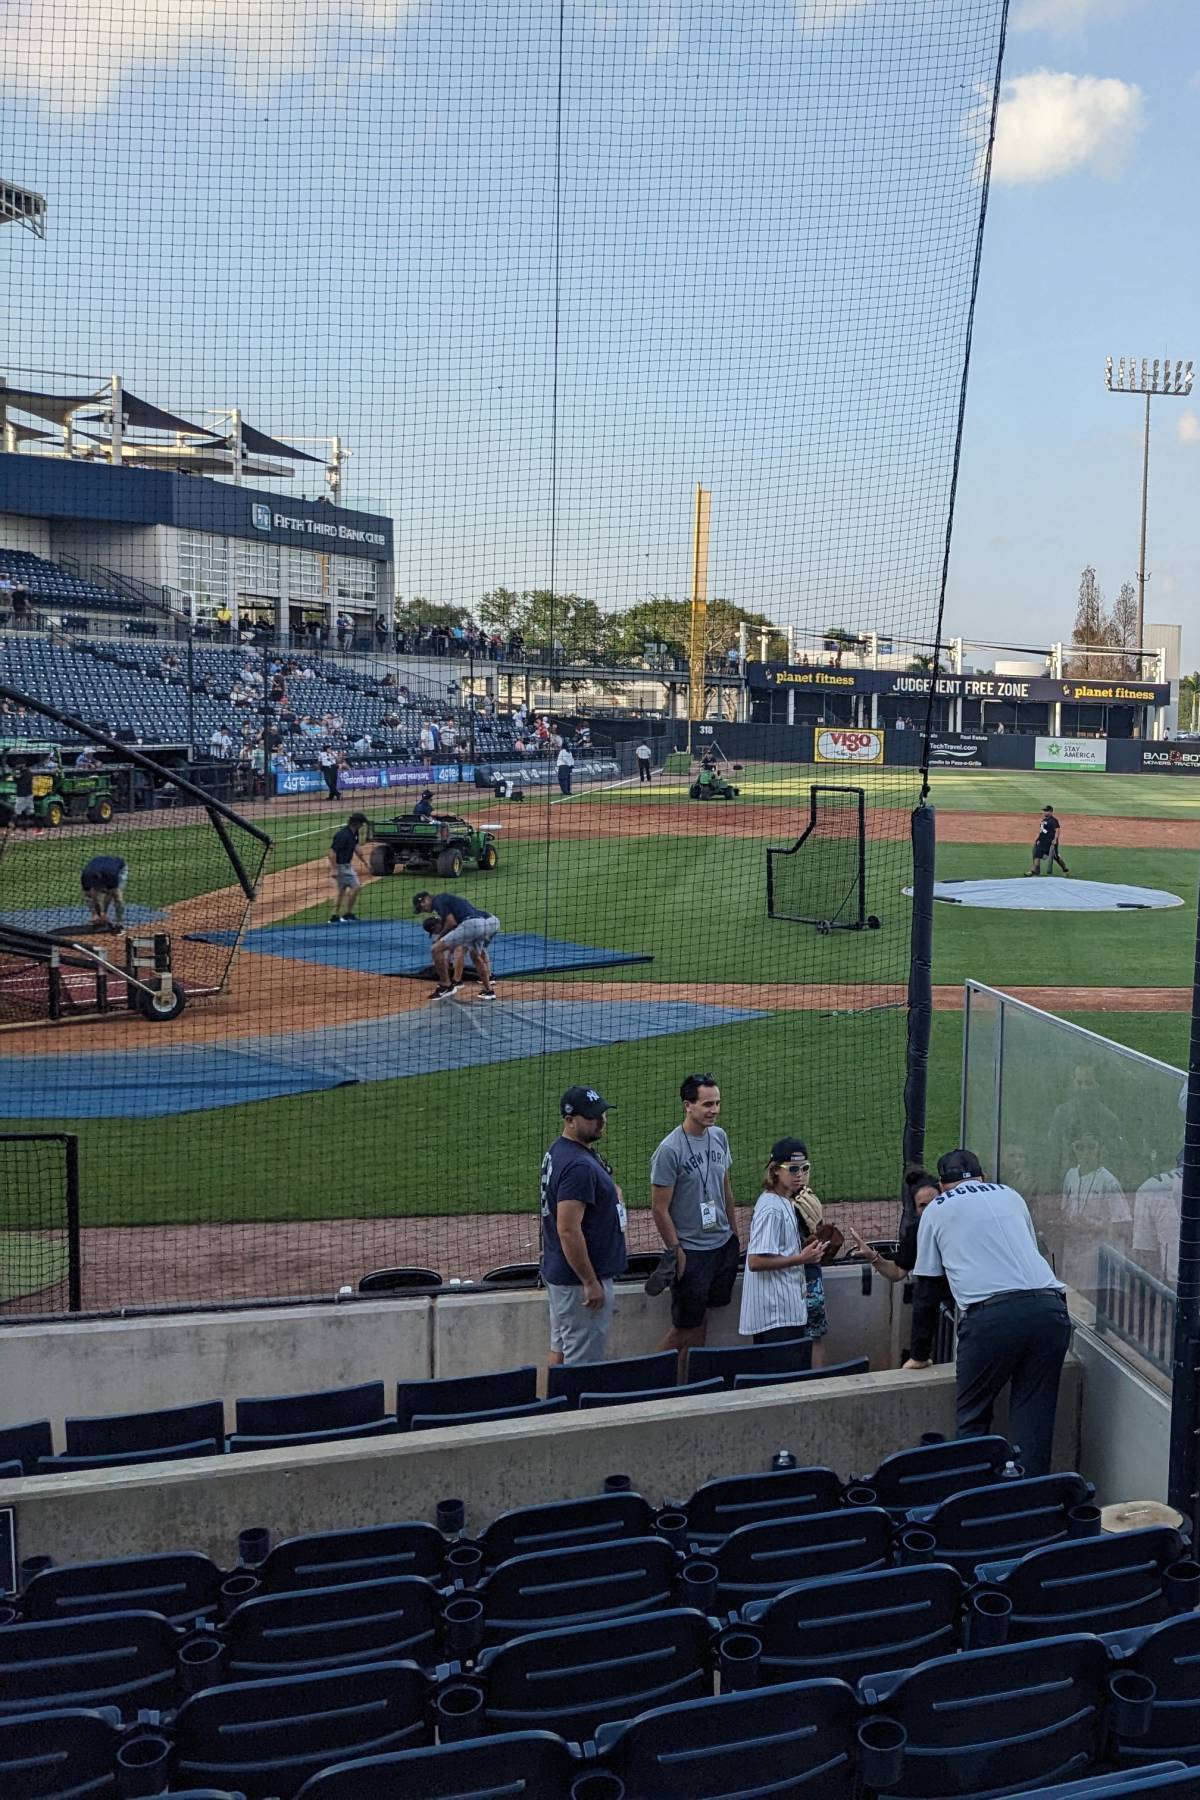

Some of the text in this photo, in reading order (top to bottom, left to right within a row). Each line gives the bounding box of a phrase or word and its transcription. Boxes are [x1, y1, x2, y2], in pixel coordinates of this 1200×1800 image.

[273, 513, 304, 531] FIFTH
[305, 520, 337, 537] THIRD
[338, 525, 366, 542] BANK
[775, 670, 855, 686] planet fitness
[964, 680, 995, 696] FREE
[997, 682, 1029, 697] ZONE
[1074, 686, 1155, 700] planet fitness
[699, 725, 714, 735] 318
[1143, 752, 1169, 761] BAD
[682, 1152, 704, 1175] NEW
[935, 1182, 1006, 1205] SECURIT
